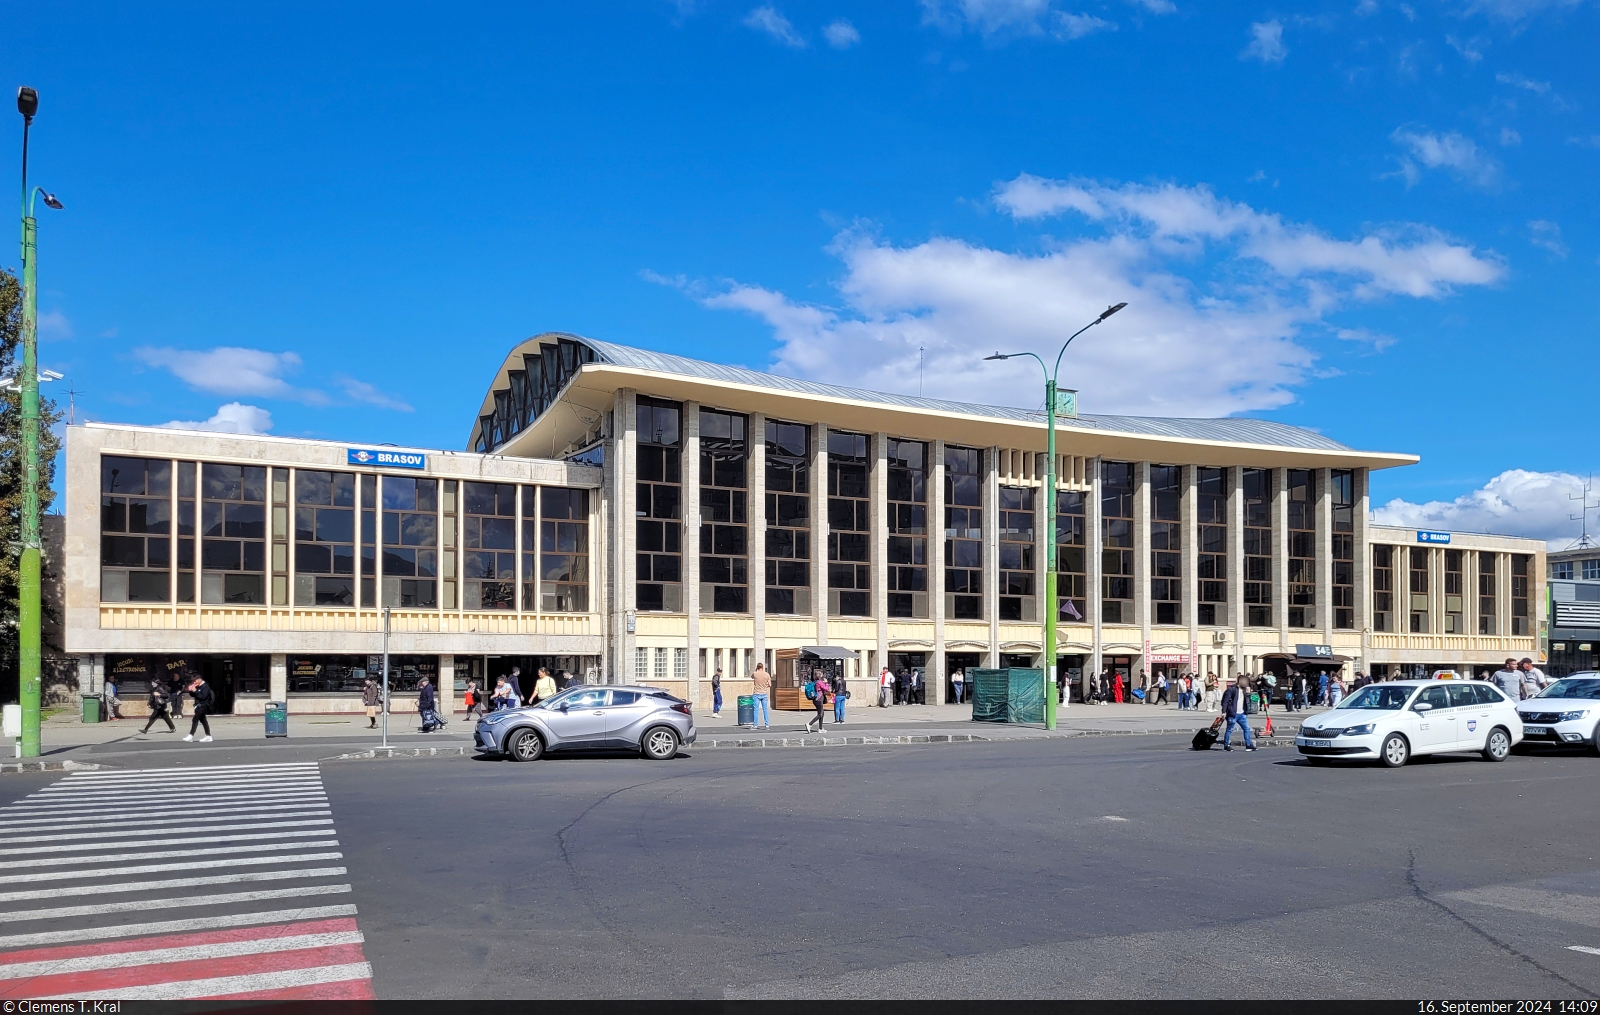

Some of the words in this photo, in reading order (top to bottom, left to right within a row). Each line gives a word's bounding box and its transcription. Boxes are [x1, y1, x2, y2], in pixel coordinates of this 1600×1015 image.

[377, 453, 422, 465] BRASOV
[1430, 533, 1450, 541] BRASOV
[1151, 654, 1181, 662] EXCHANGE
[166, 659, 187, 671] BAR
